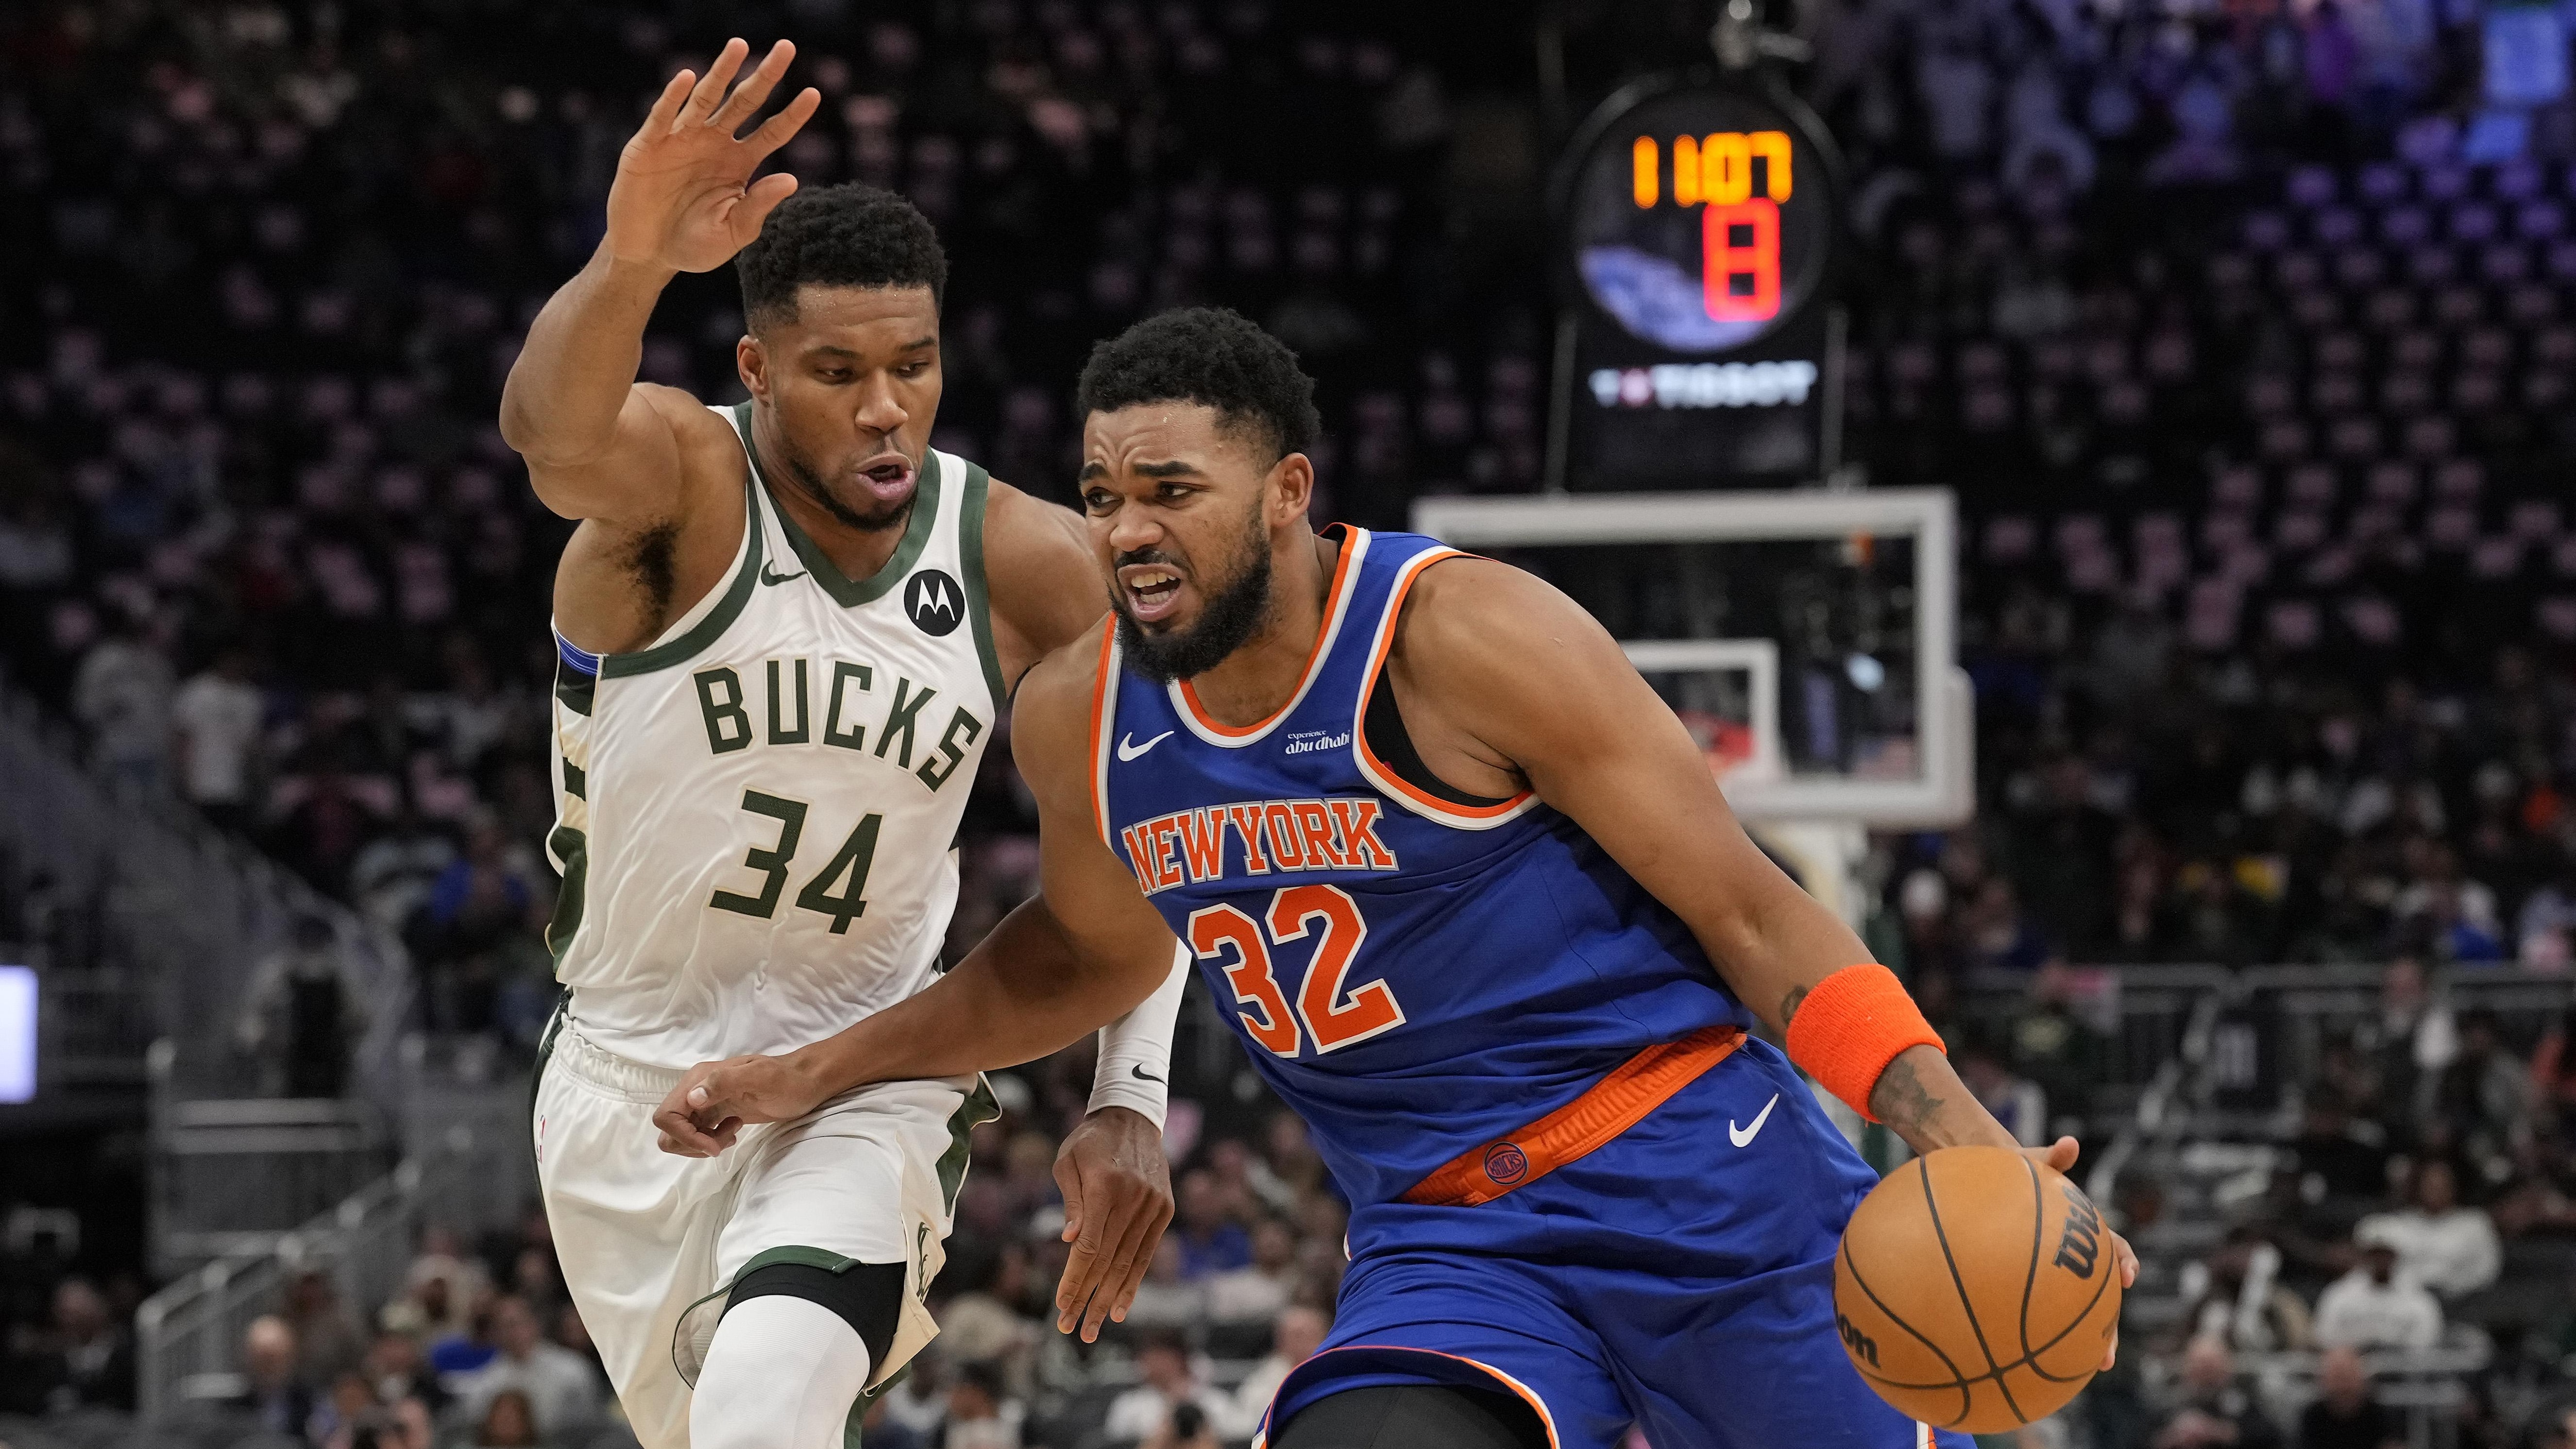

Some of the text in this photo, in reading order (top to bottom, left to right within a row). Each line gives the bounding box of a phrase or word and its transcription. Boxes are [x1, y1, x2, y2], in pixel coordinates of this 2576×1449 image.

[1702, 197, 1781, 322] 8
[691, 658, 984, 794] BUCKS
[1285, 729, 1351, 754] abu dhabi
[1287, 730, 1327, 740] experience
[708, 788, 883, 935] 34
[1121, 798, 1399, 897] NEW YORK
[1187, 884, 1406, 1058] 32
[1488, 1153, 1522, 1175] KNICKS
